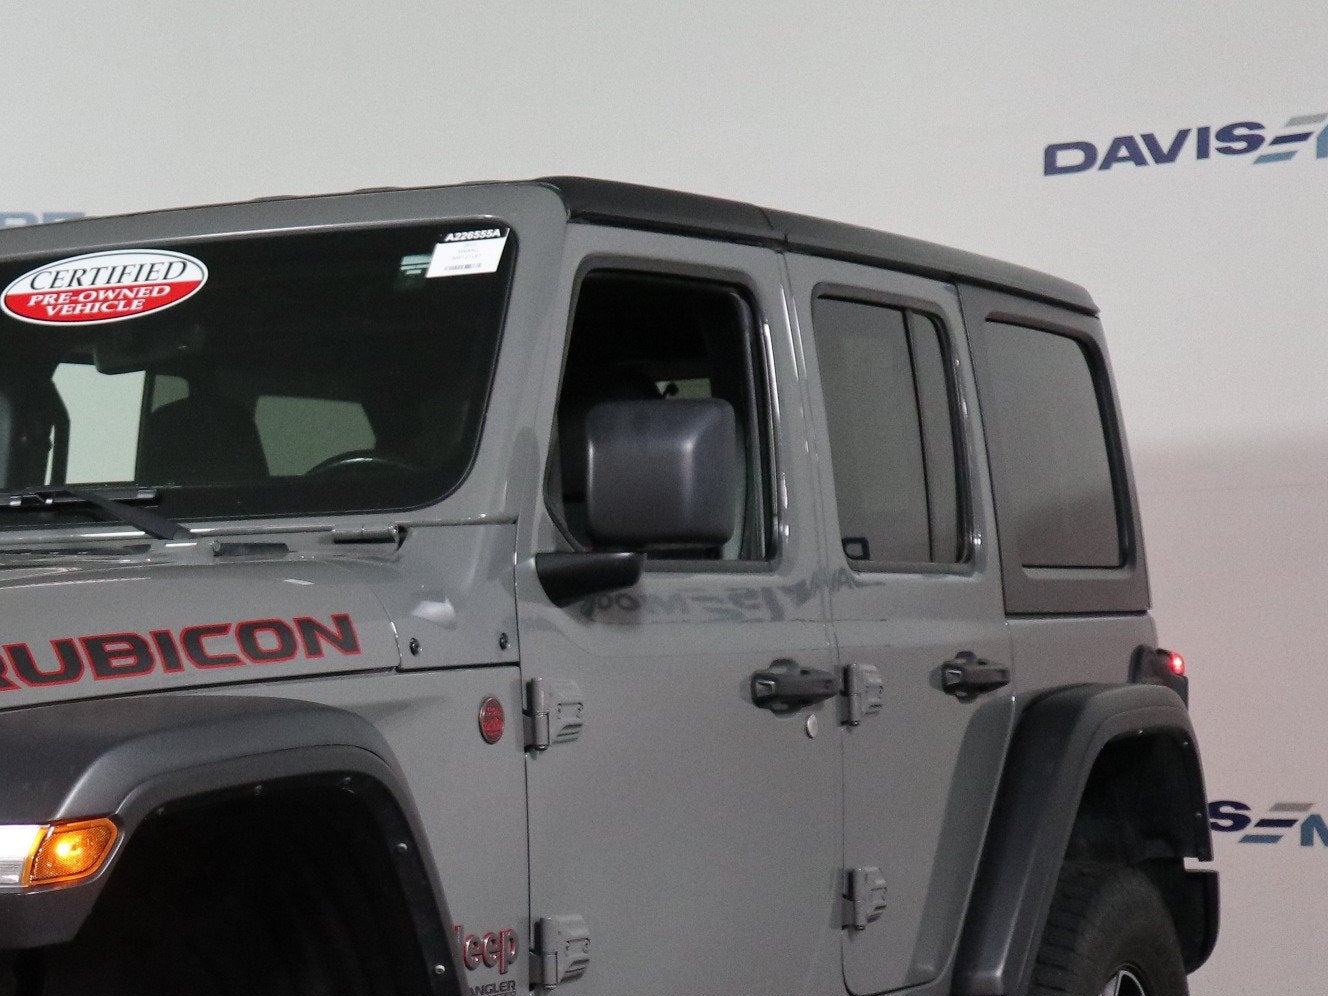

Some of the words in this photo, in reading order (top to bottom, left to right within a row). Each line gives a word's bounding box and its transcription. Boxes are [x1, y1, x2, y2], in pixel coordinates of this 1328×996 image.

[1044, 121, 1266, 176] DAVIS
[30, 260, 188, 291] CERTIFIED
[27, 285, 171, 307] PRE-OWNED
[45, 299, 146, 317] VEHICLE
